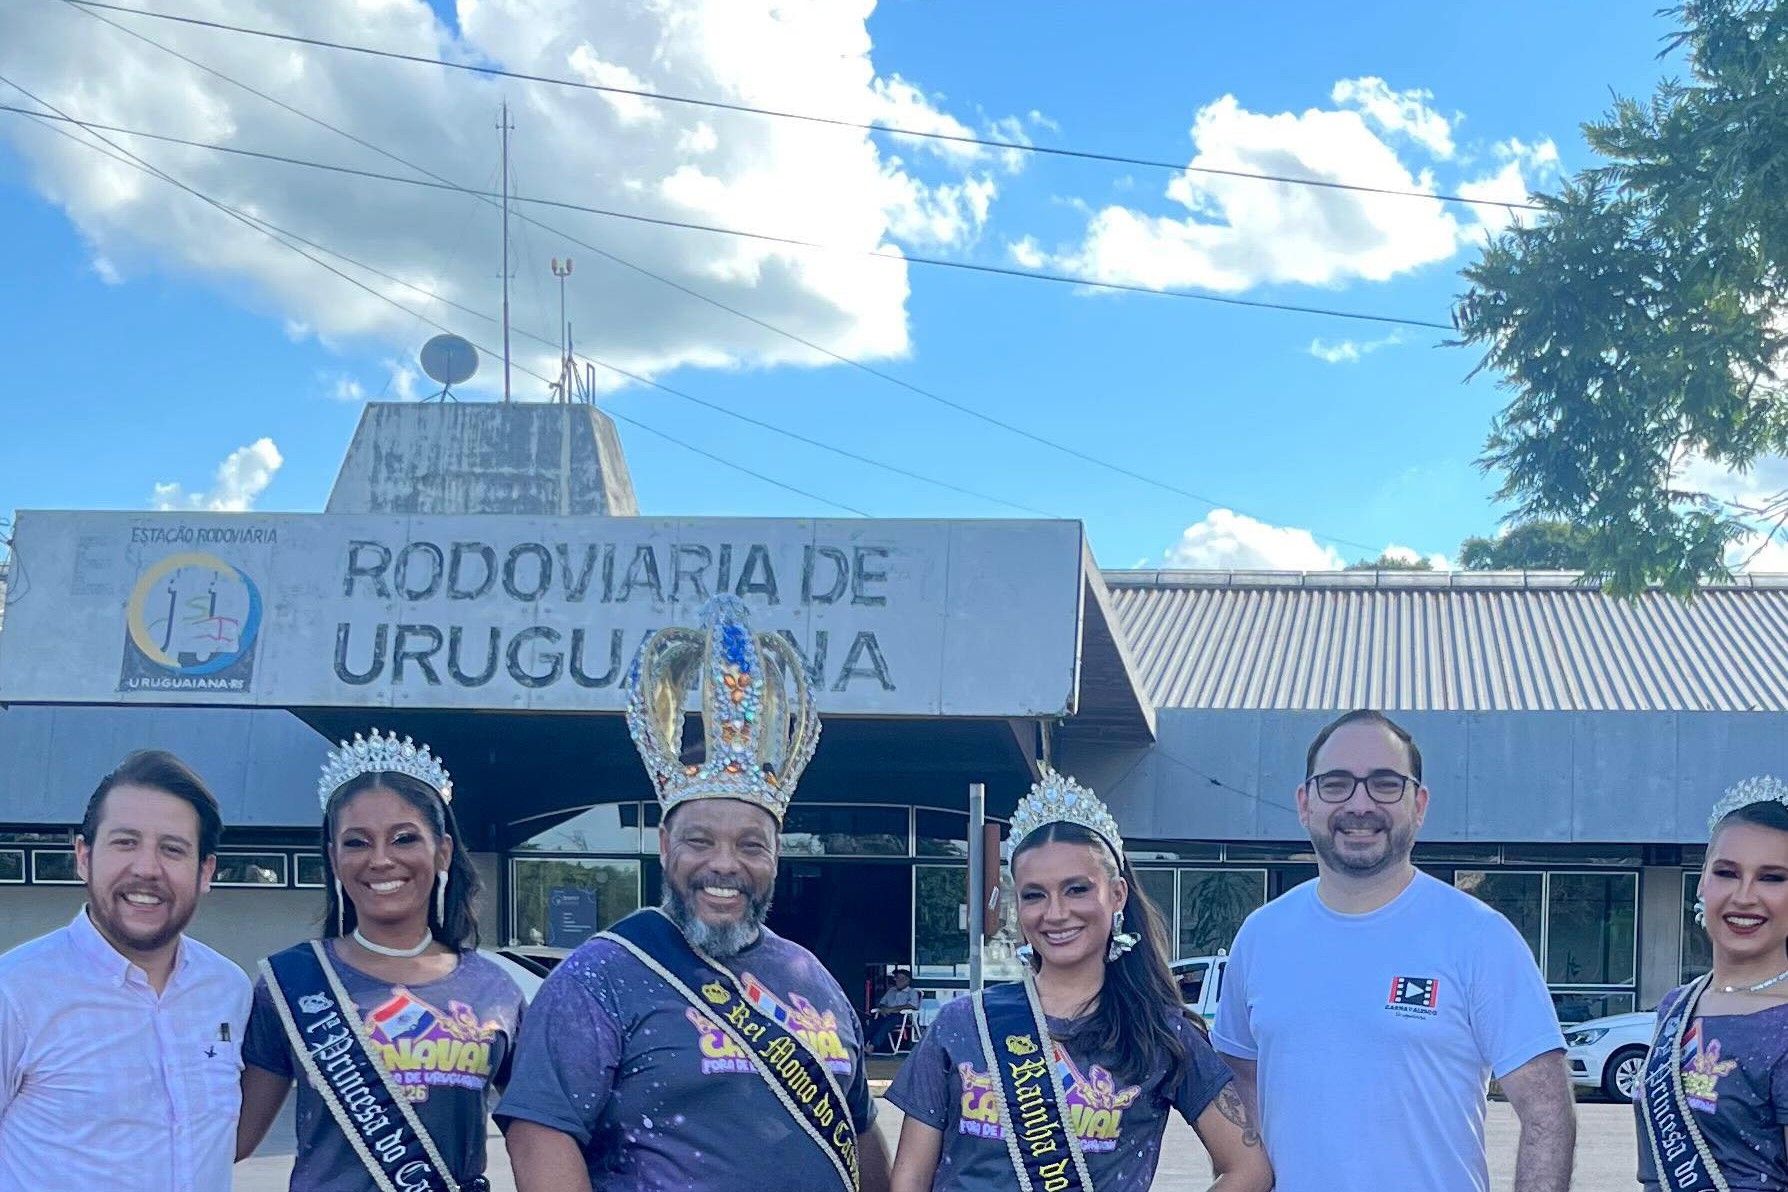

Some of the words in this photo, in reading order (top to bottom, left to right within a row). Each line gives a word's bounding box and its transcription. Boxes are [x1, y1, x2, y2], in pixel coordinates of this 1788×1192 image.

[131, 525, 194, 545] ESTAÇÃO
[342, 540, 781, 606] RODOVIARIA
[801, 544, 891, 607] DE
[334, 621, 897, 692] URUGUNA
[374, 1037, 491, 1076] NAVAL
[724, 1001, 767, 1043] Rei
[813, 1092, 834, 1128] do
[311, 1026, 391, 1137] Princesa
[375, 1126, 408, 1163] do
[1008, 1056, 1063, 1158] Rainha
[1674, 1153, 1699, 1189] do
